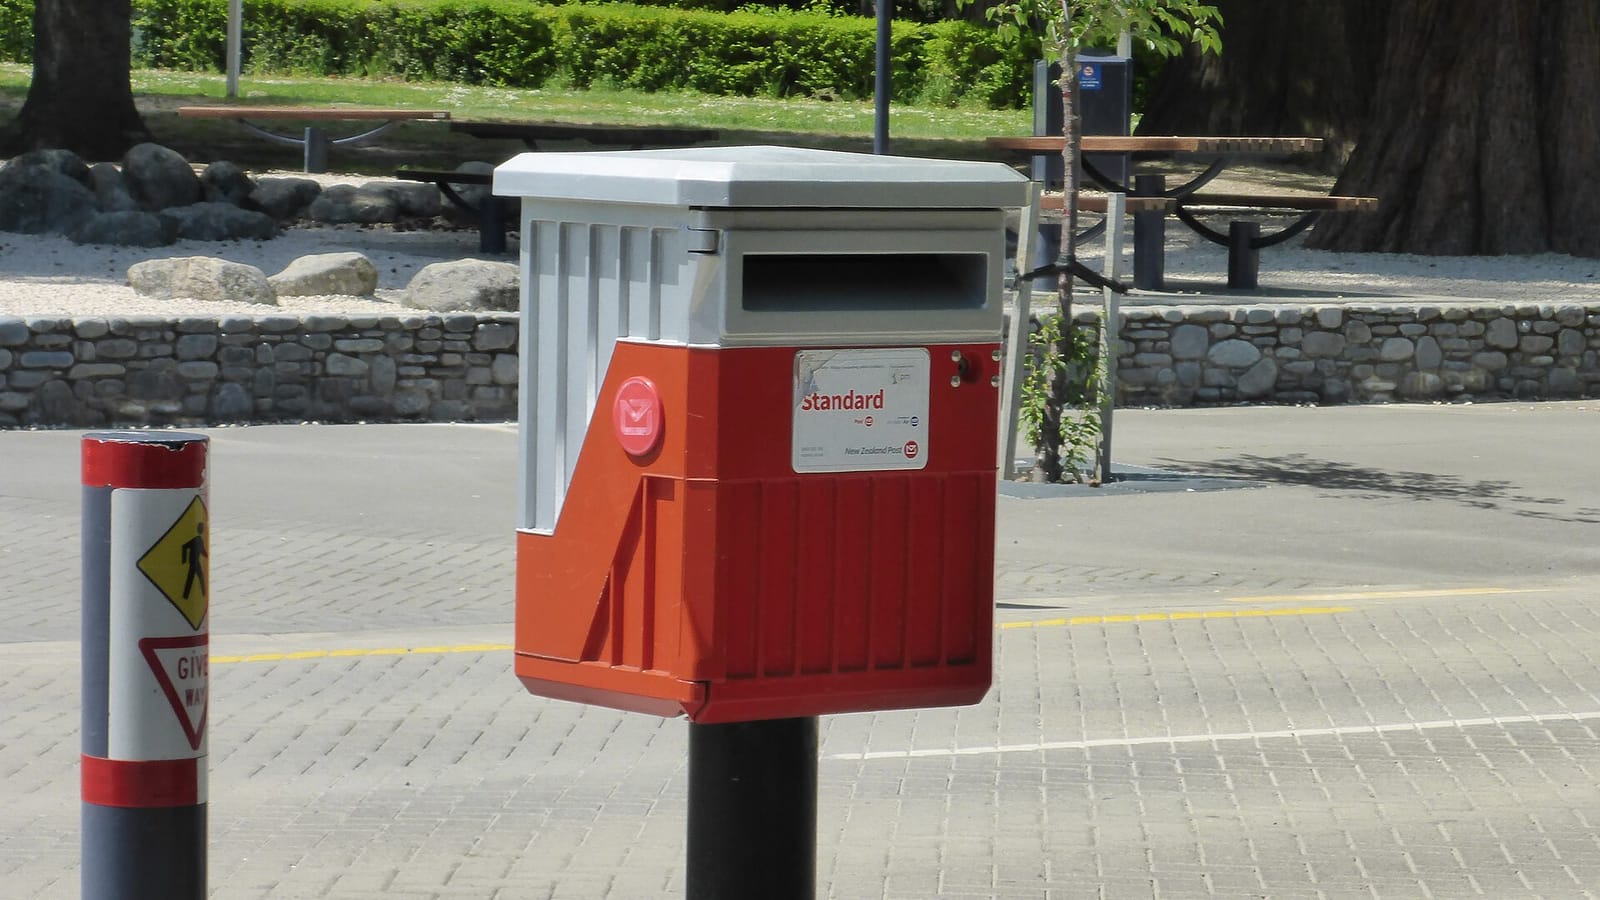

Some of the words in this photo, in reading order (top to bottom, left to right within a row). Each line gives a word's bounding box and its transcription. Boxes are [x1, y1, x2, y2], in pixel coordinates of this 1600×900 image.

[801, 389, 884, 411] Standard
[845, 447, 860, 455] New
[861, 446, 887, 455] Zealand
[887, 446, 903, 454] Post
